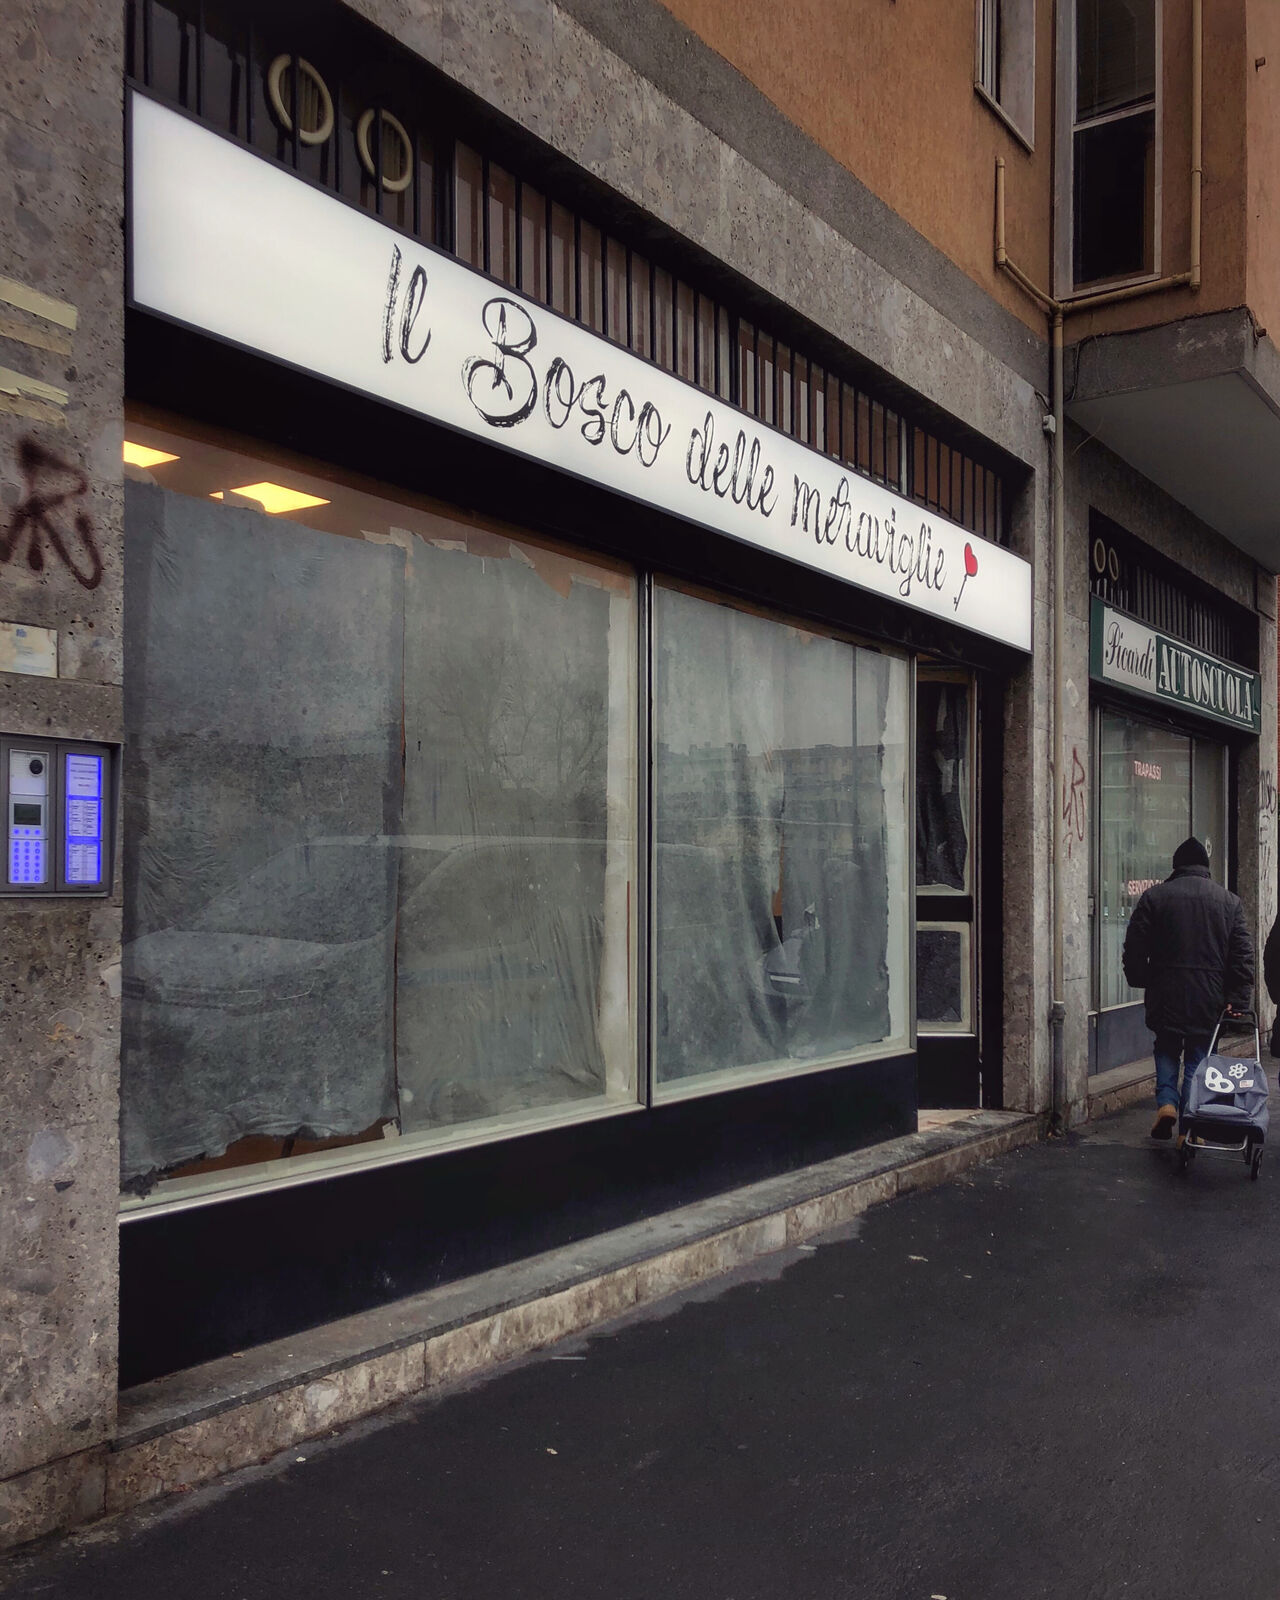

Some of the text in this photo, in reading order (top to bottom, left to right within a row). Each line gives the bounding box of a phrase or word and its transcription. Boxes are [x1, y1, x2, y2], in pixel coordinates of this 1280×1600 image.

[382, 243, 948, 597] Il Bosco delle meraviglie
[1105, 621, 1253, 722] Picardi AUTOSCUOLA
